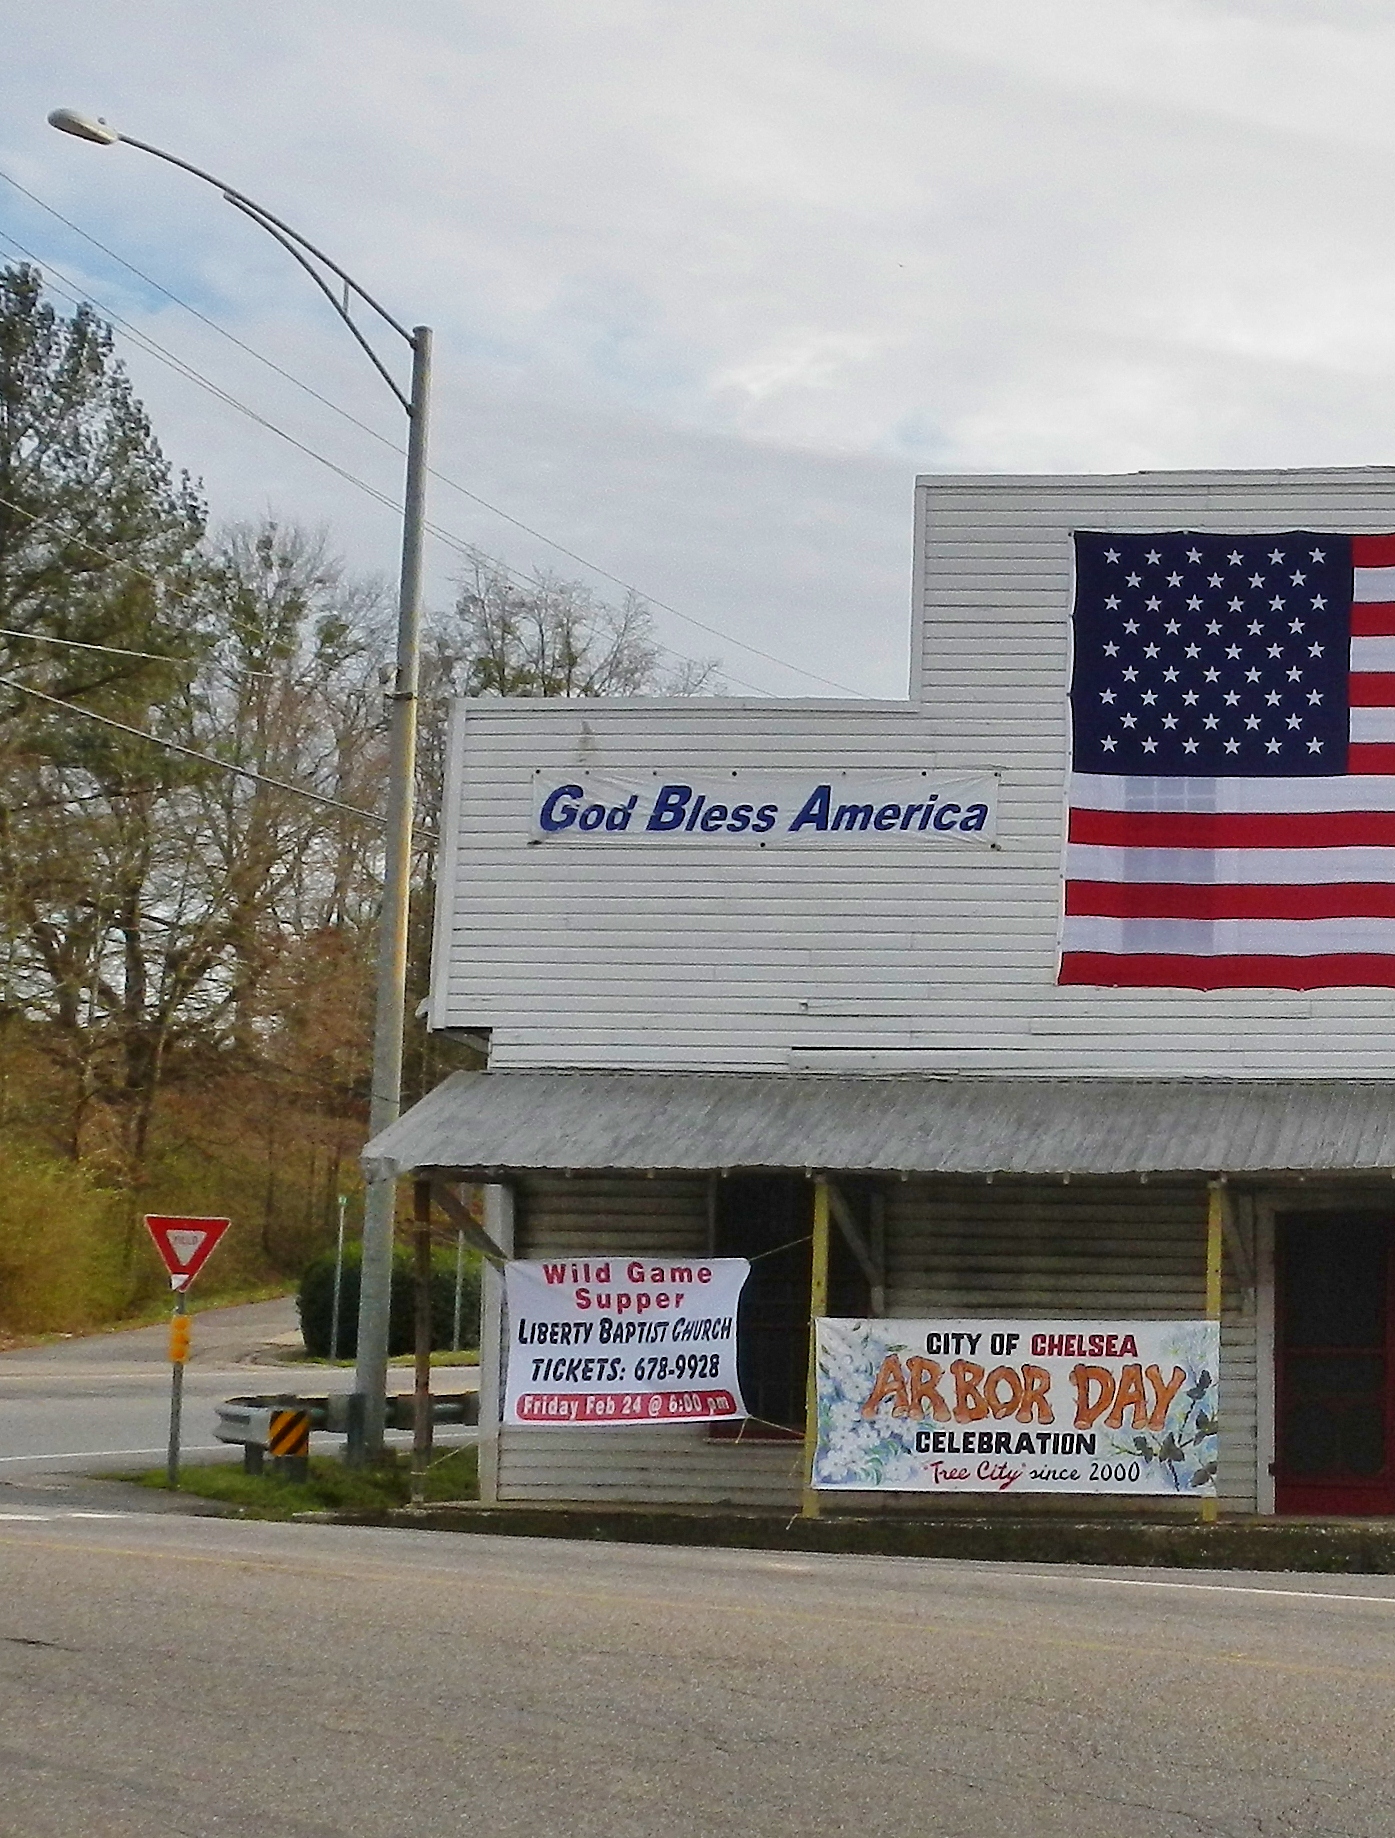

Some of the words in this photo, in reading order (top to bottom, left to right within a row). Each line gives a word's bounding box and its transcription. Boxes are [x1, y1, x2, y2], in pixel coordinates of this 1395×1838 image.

[539, 784, 638, 832] God
[646, 784, 779, 833] Bless
[788, 784, 989, 832] America
[543, 1262, 611, 1284] Wild
[627, 1261, 713, 1284] Game
[575, 1287, 685, 1314] Supper
[518, 1318, 594, 1345] LIBERTY
[600, 1317, 669, 1344] BAPTIST
[672, 1317, 733, 1342] CHURCH
[926, 1332, 982, 1356] CITY
[990, 1332, 1020, 1356] OF
[1031, 1333, 1139, 1358] CHELSEA
[532, 1357, 626, 1382] TICKETS:
[634, 1354, 720, 1381] 678-9928
[861, 1353, 1055, 1425] ARBOR
[1069, 1362, 1187, 1431] DAY
[523, 1395, 579, 1420] Friday
[585, 1394, 616, 1415] Feb
[623, 1394, 641, 1413] 24
[648, 1394, 663, 1416] @
[668, 1393, 701, 1413] 6:00
[708, 1395, 729, 1415] pm
[915, 1431, 1096, 1455] CELEBRATION
[1029, 1464, 1081, 1481] since
[1089, 1461, 1140, 1483] 2000
